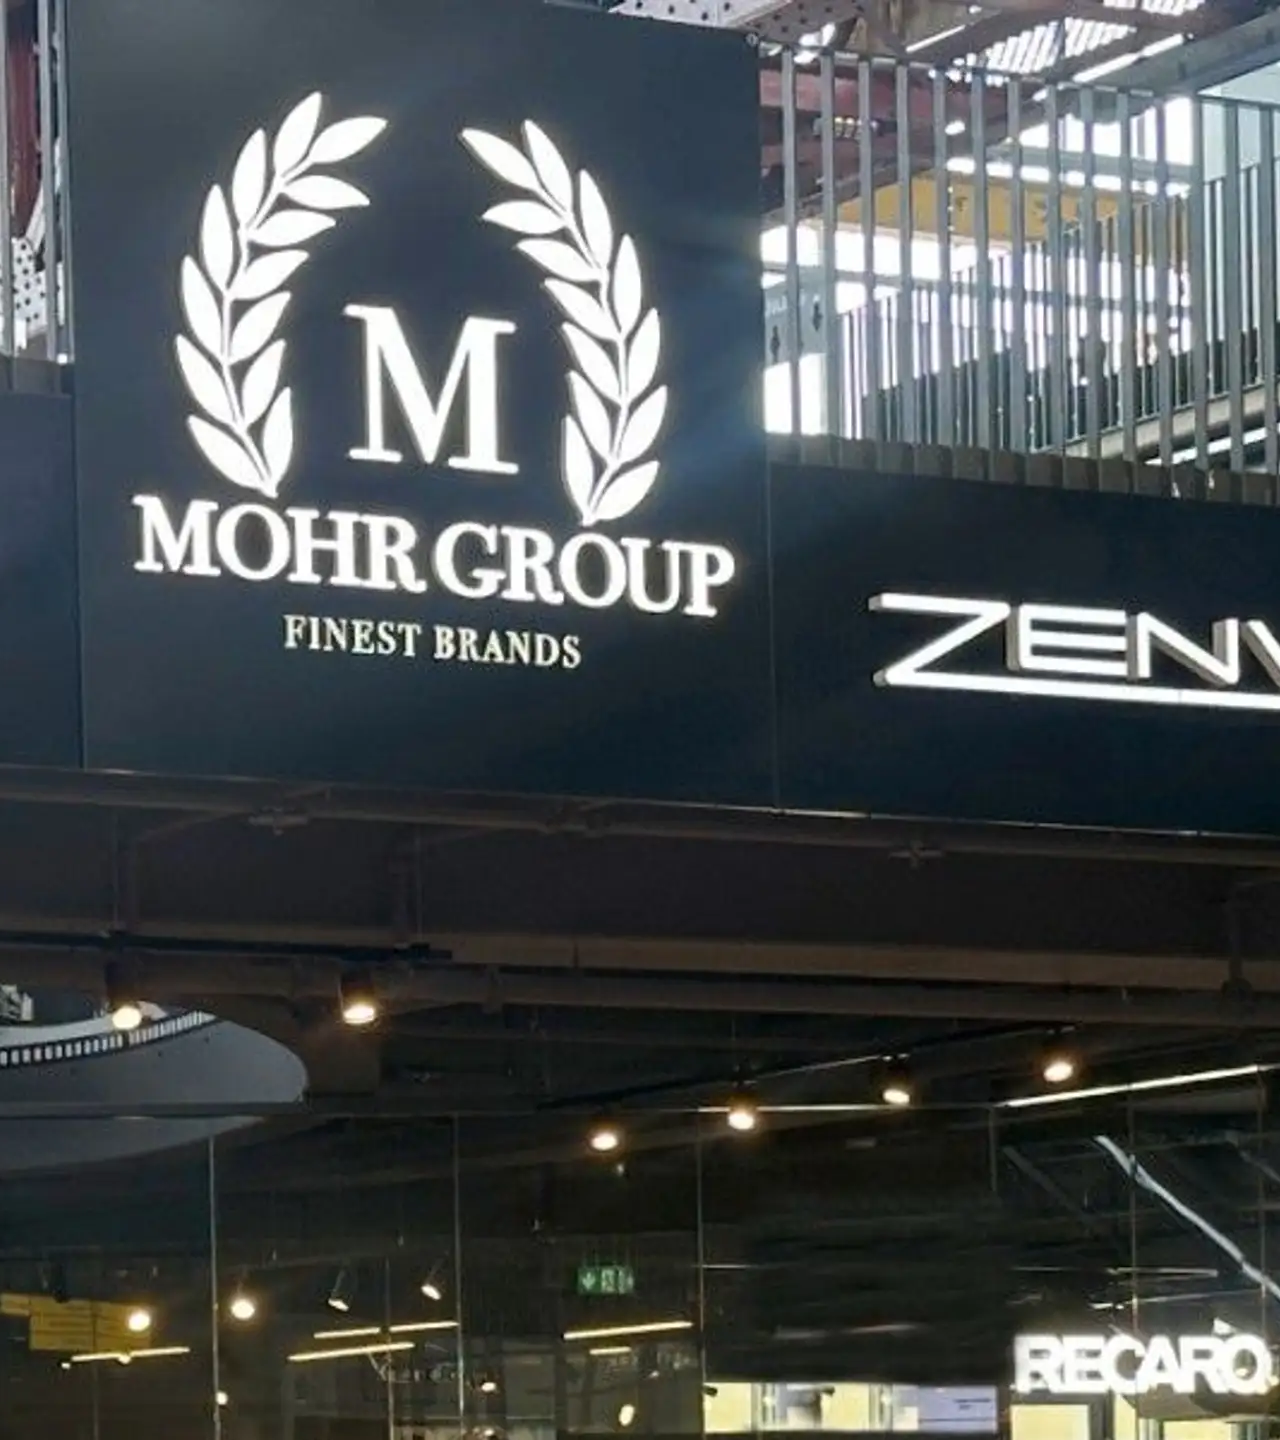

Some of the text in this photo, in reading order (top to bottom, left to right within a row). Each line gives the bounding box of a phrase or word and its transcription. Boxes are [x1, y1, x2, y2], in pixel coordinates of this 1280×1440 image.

[343, 303, 519, 475] M
[131, 493, 736, 618] MOHR GROUP
[283, 613, 583, 669] FINEST BRANDS
[1013, 1332, 1272, 1396] RECARO
